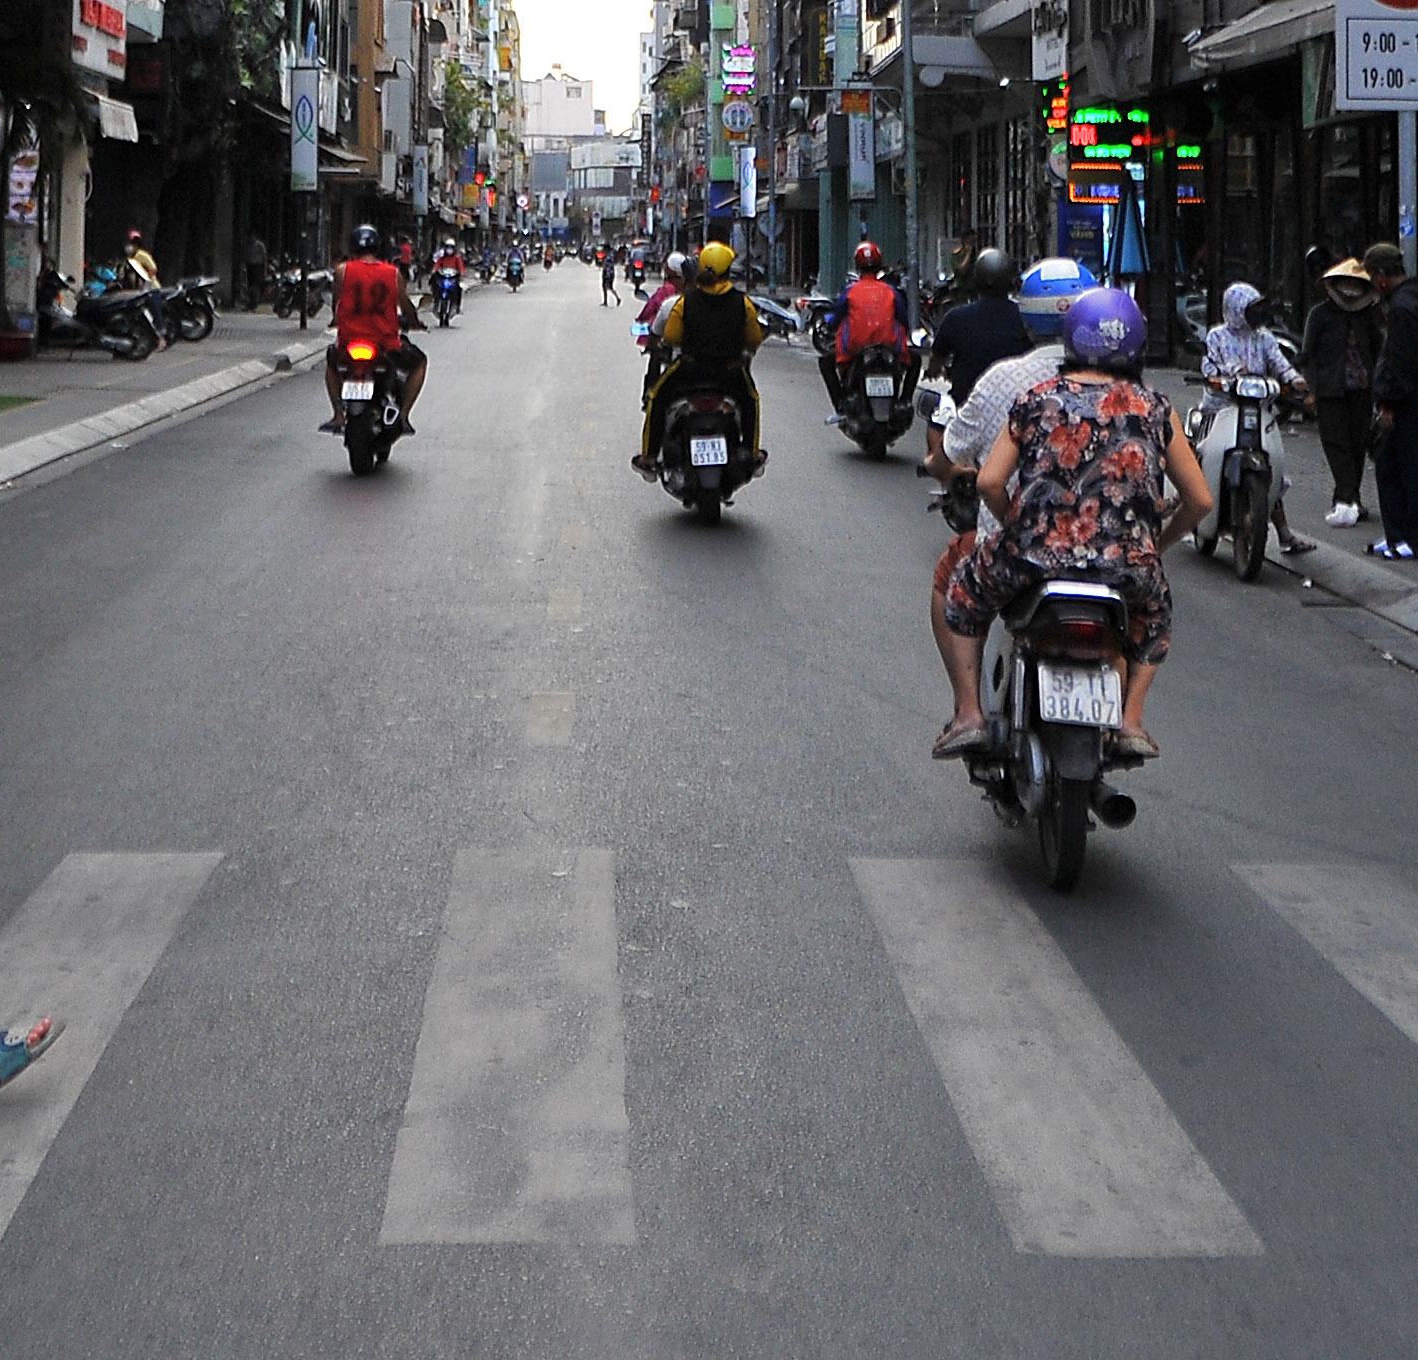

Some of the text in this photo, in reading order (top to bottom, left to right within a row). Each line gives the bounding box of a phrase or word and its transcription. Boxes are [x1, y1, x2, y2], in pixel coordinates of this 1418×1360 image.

[1362, 33, 1397, 55] 9:00
[1362, 68, 1404, 90] 19:00
[1046, 695, 1116, 724] 384.07
